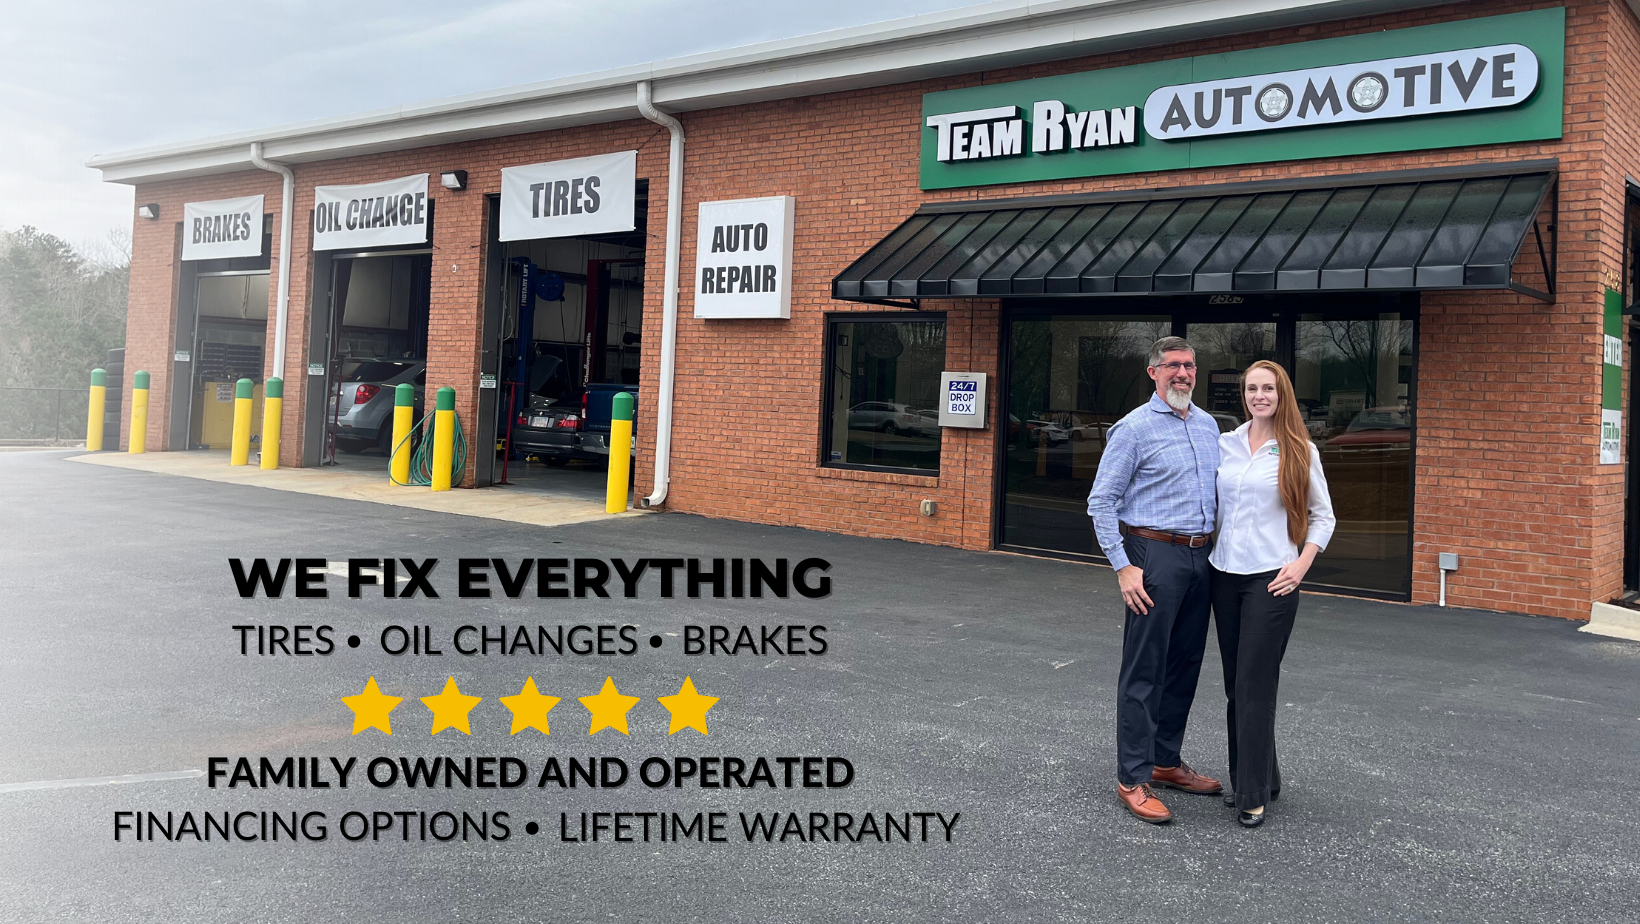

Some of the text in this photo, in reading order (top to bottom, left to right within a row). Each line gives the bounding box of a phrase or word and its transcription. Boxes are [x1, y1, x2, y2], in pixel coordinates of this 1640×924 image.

[926, 52, 1516, 162] TEAM RYAN AUTOMOTIVE
[315, 191, 425, 234] OIL CHANGE
[529, 175, 601, 219] TIRES
[192, 211, 251, 244] BRAKES
[711, 222, 768, 253] AUTO
[701, 264, 777, 294] REPAIR
[951, 382, 975, 390] 24/7
[951, 393, 974, 401] DROP
[952, 403, 971, 412] BOX
